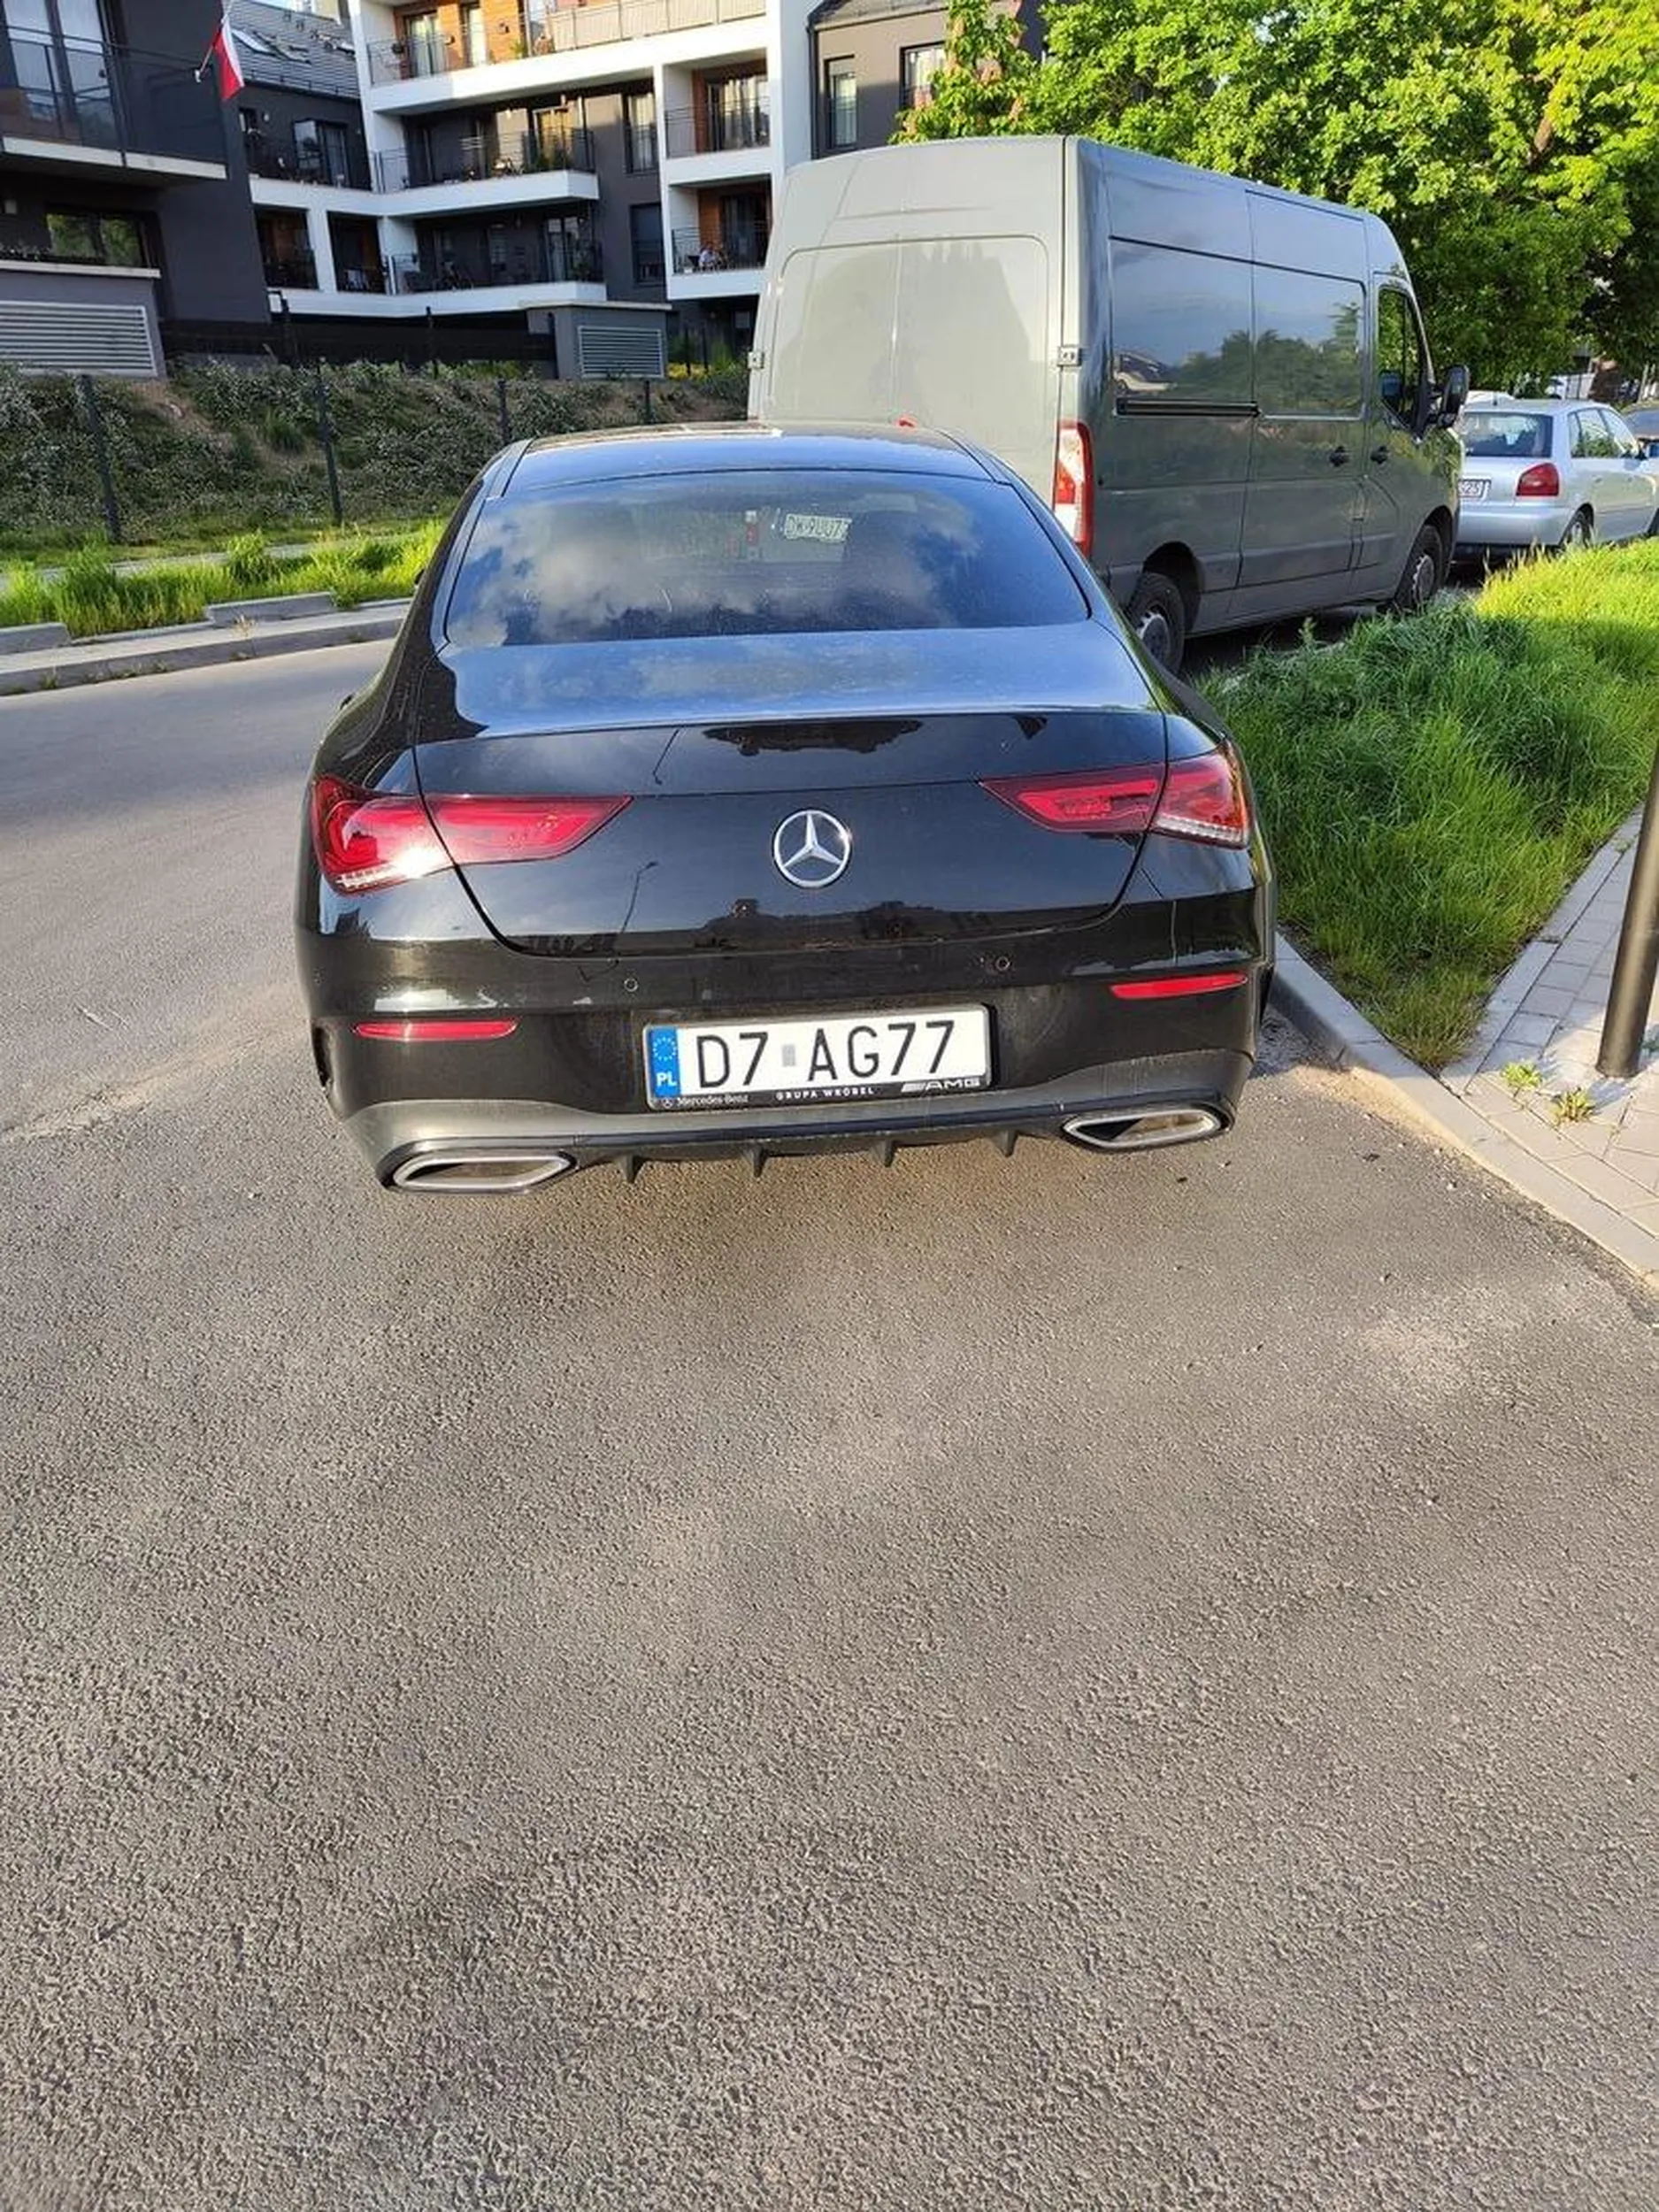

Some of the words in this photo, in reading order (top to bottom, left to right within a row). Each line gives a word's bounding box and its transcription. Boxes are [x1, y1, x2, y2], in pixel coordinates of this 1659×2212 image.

[695, 1032, 769, 1088] D7
[808, 1019, 956, 1082] AG77
[656, 1071, 678, 1087] PL
